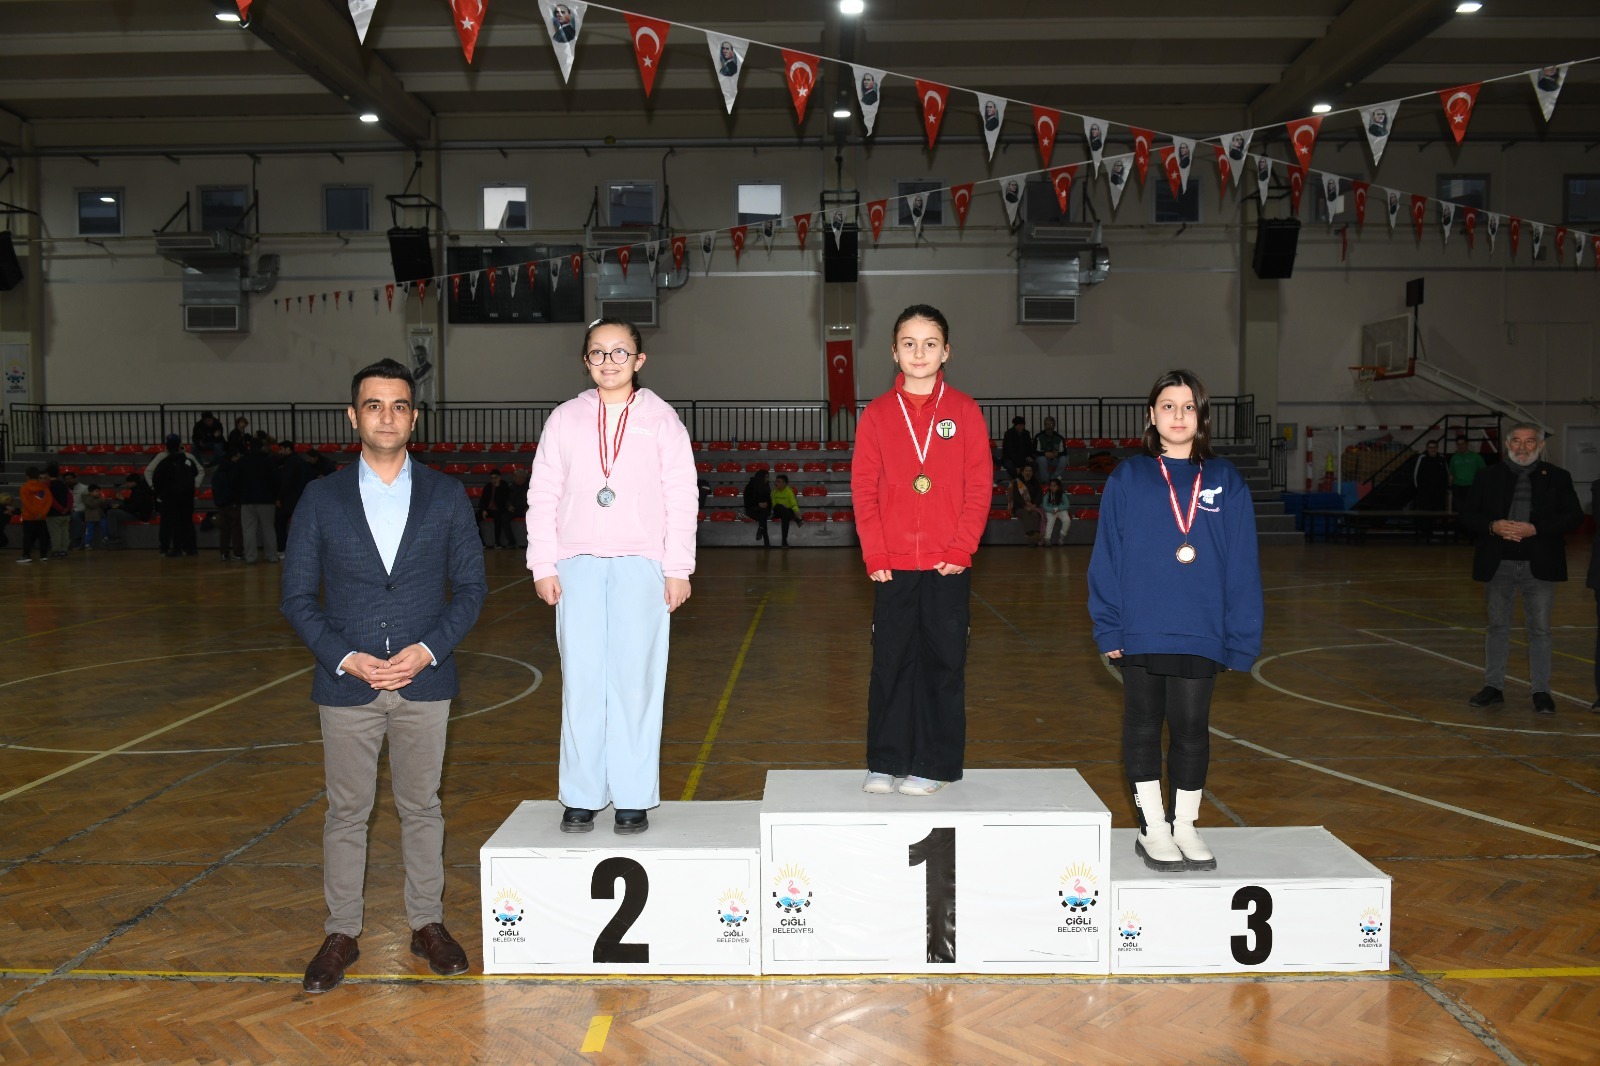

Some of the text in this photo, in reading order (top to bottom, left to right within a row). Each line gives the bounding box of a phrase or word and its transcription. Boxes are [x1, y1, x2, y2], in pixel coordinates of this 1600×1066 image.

[591, 857, 649, 963] 2
[780, 916, 806, 927] ÇİĞLİ
[909, 828, 955, 963] 1
[1065, 915, 1092, 926] ÇİĞLİ
[1231, 886, 1272, 965] 3
